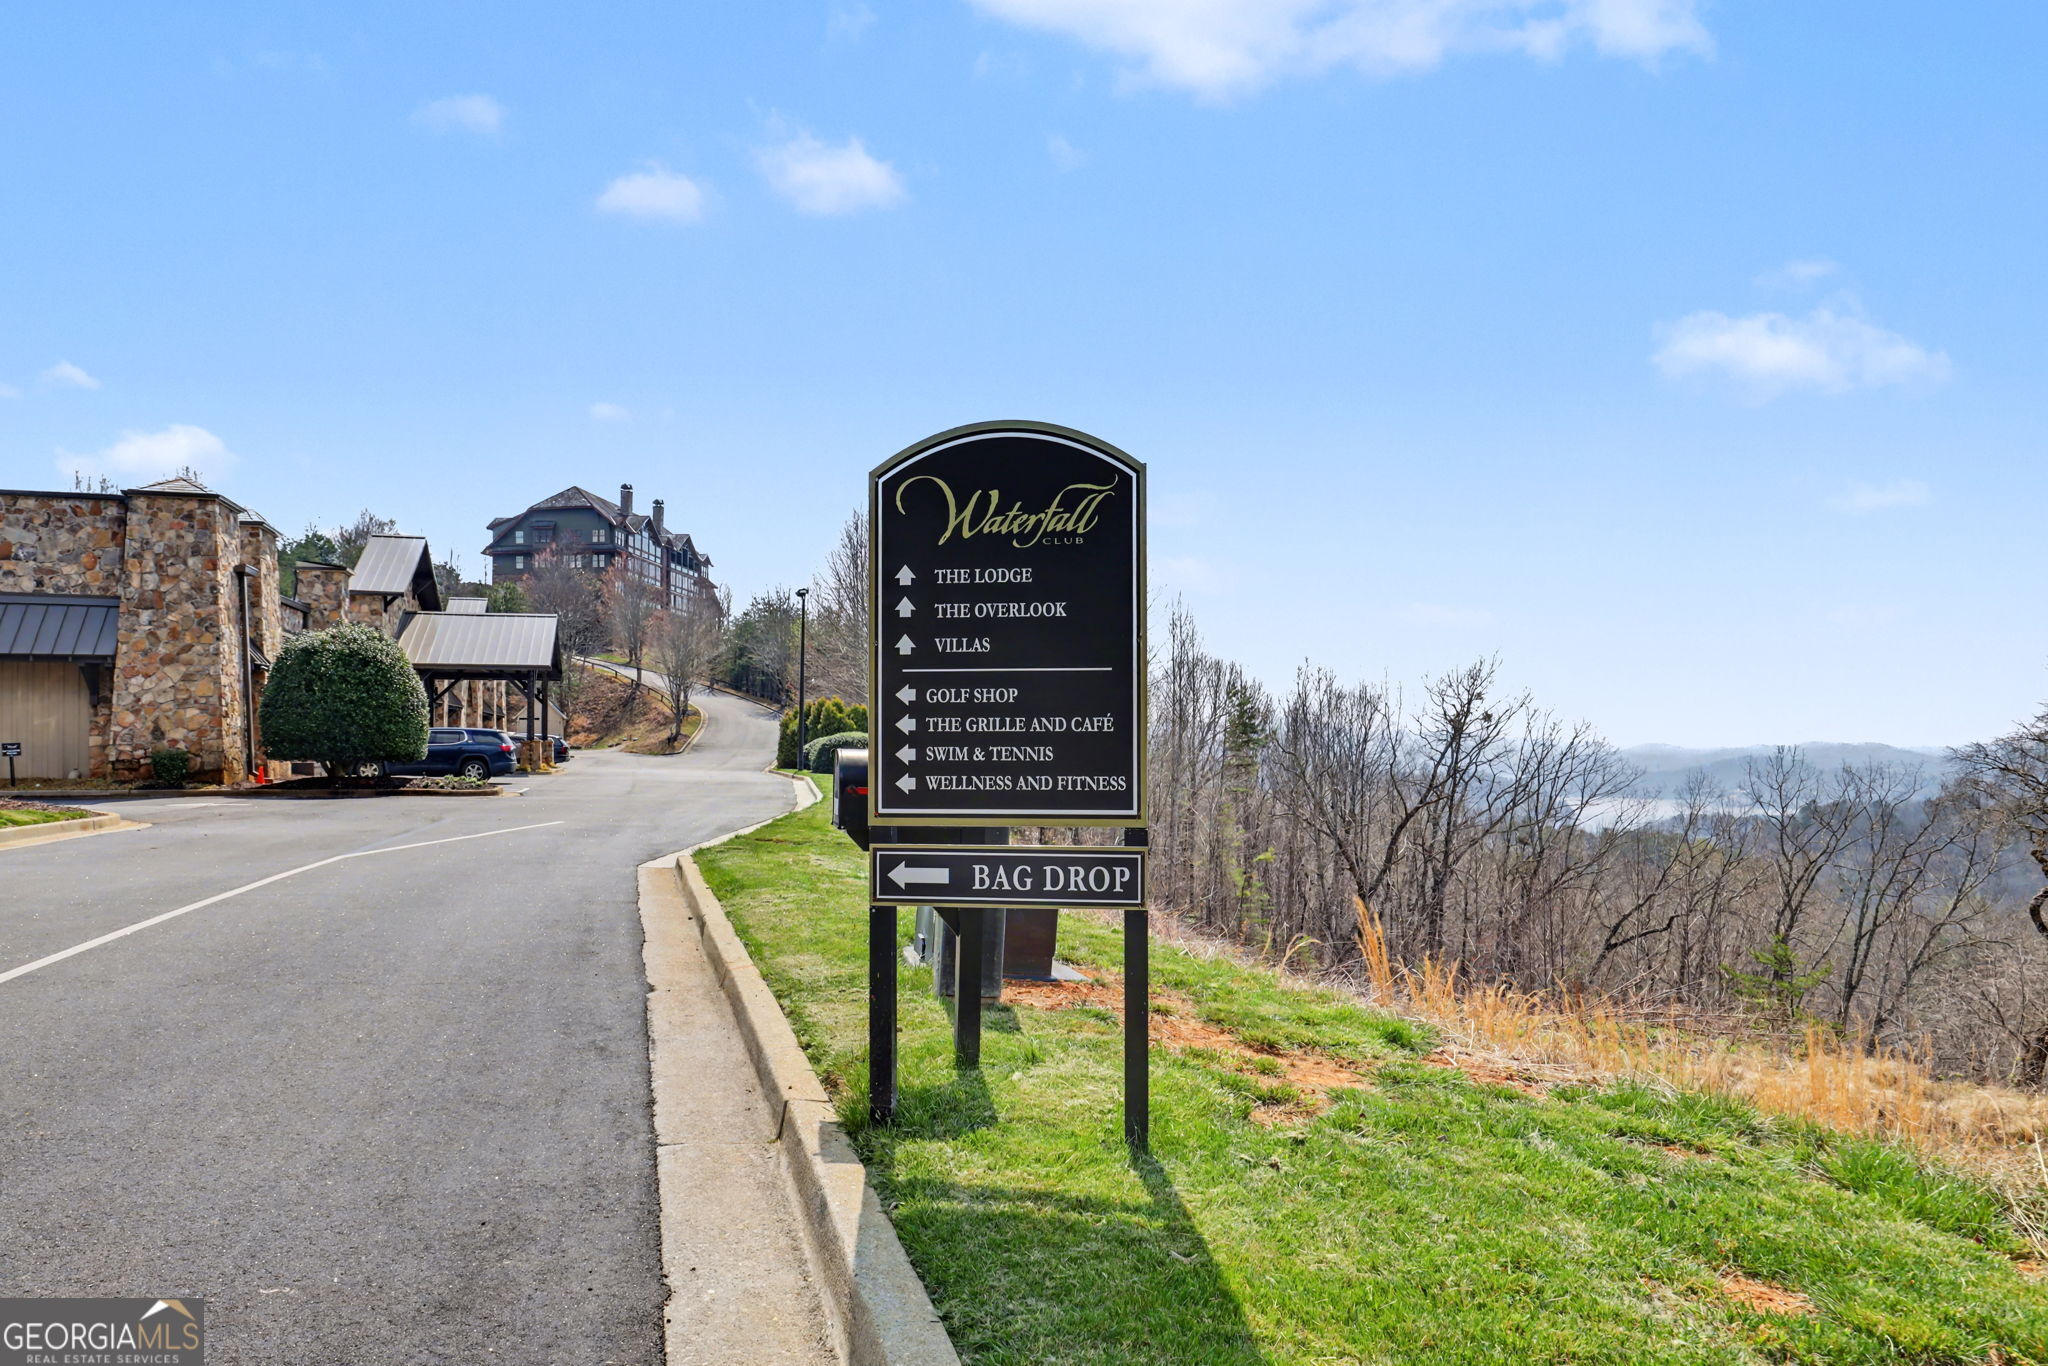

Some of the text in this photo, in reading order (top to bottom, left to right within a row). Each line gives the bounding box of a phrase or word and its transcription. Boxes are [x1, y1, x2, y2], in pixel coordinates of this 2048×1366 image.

[896, 474, 1118, 548] Waterfall
[934, 568, 1032, 583] THE LODGE
[935, 602, 1066, 618] THE OVERLOOK
[935, 638, 990, 652] VILLAS
[926, 688, 1018, 703] GOLF SHOP
[926, 713, 1114, 732] THE GRILLE AND CAFÉ
[926, 746, 1053, 761] SWIM & TENNIS
[926, 776, 1126, 791] WELLNESS AND FITNESS
[972, 865, 1130, 892] BAG DROP
